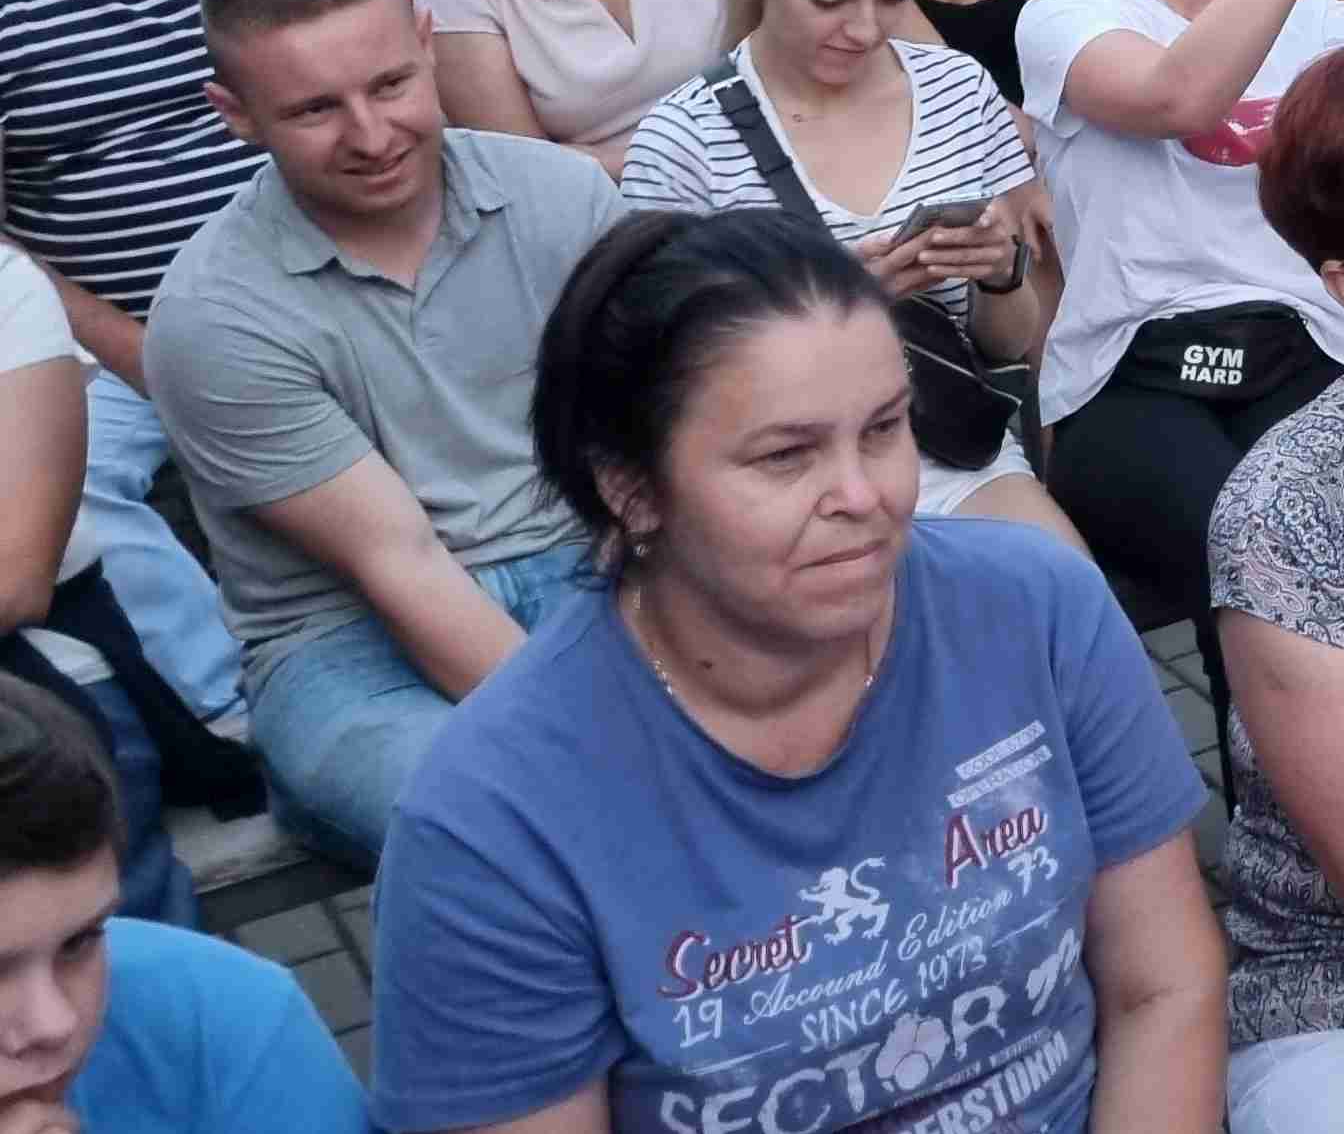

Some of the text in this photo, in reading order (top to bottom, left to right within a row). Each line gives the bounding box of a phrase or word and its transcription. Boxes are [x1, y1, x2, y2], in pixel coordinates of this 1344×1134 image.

[1180, 364, 1243, 385] HARD
[1183, 344, 1244, 368] GYM
[657, 805, 1049, 1002] Secret Area
[673, 999, 724, 1049] 19
[898, 891, 1013, 960] Edition
[1008, 846, 1060, 896] 73
[800, 978, 909, 1053] SINCE
[917, 936, 988, 998] 1973
